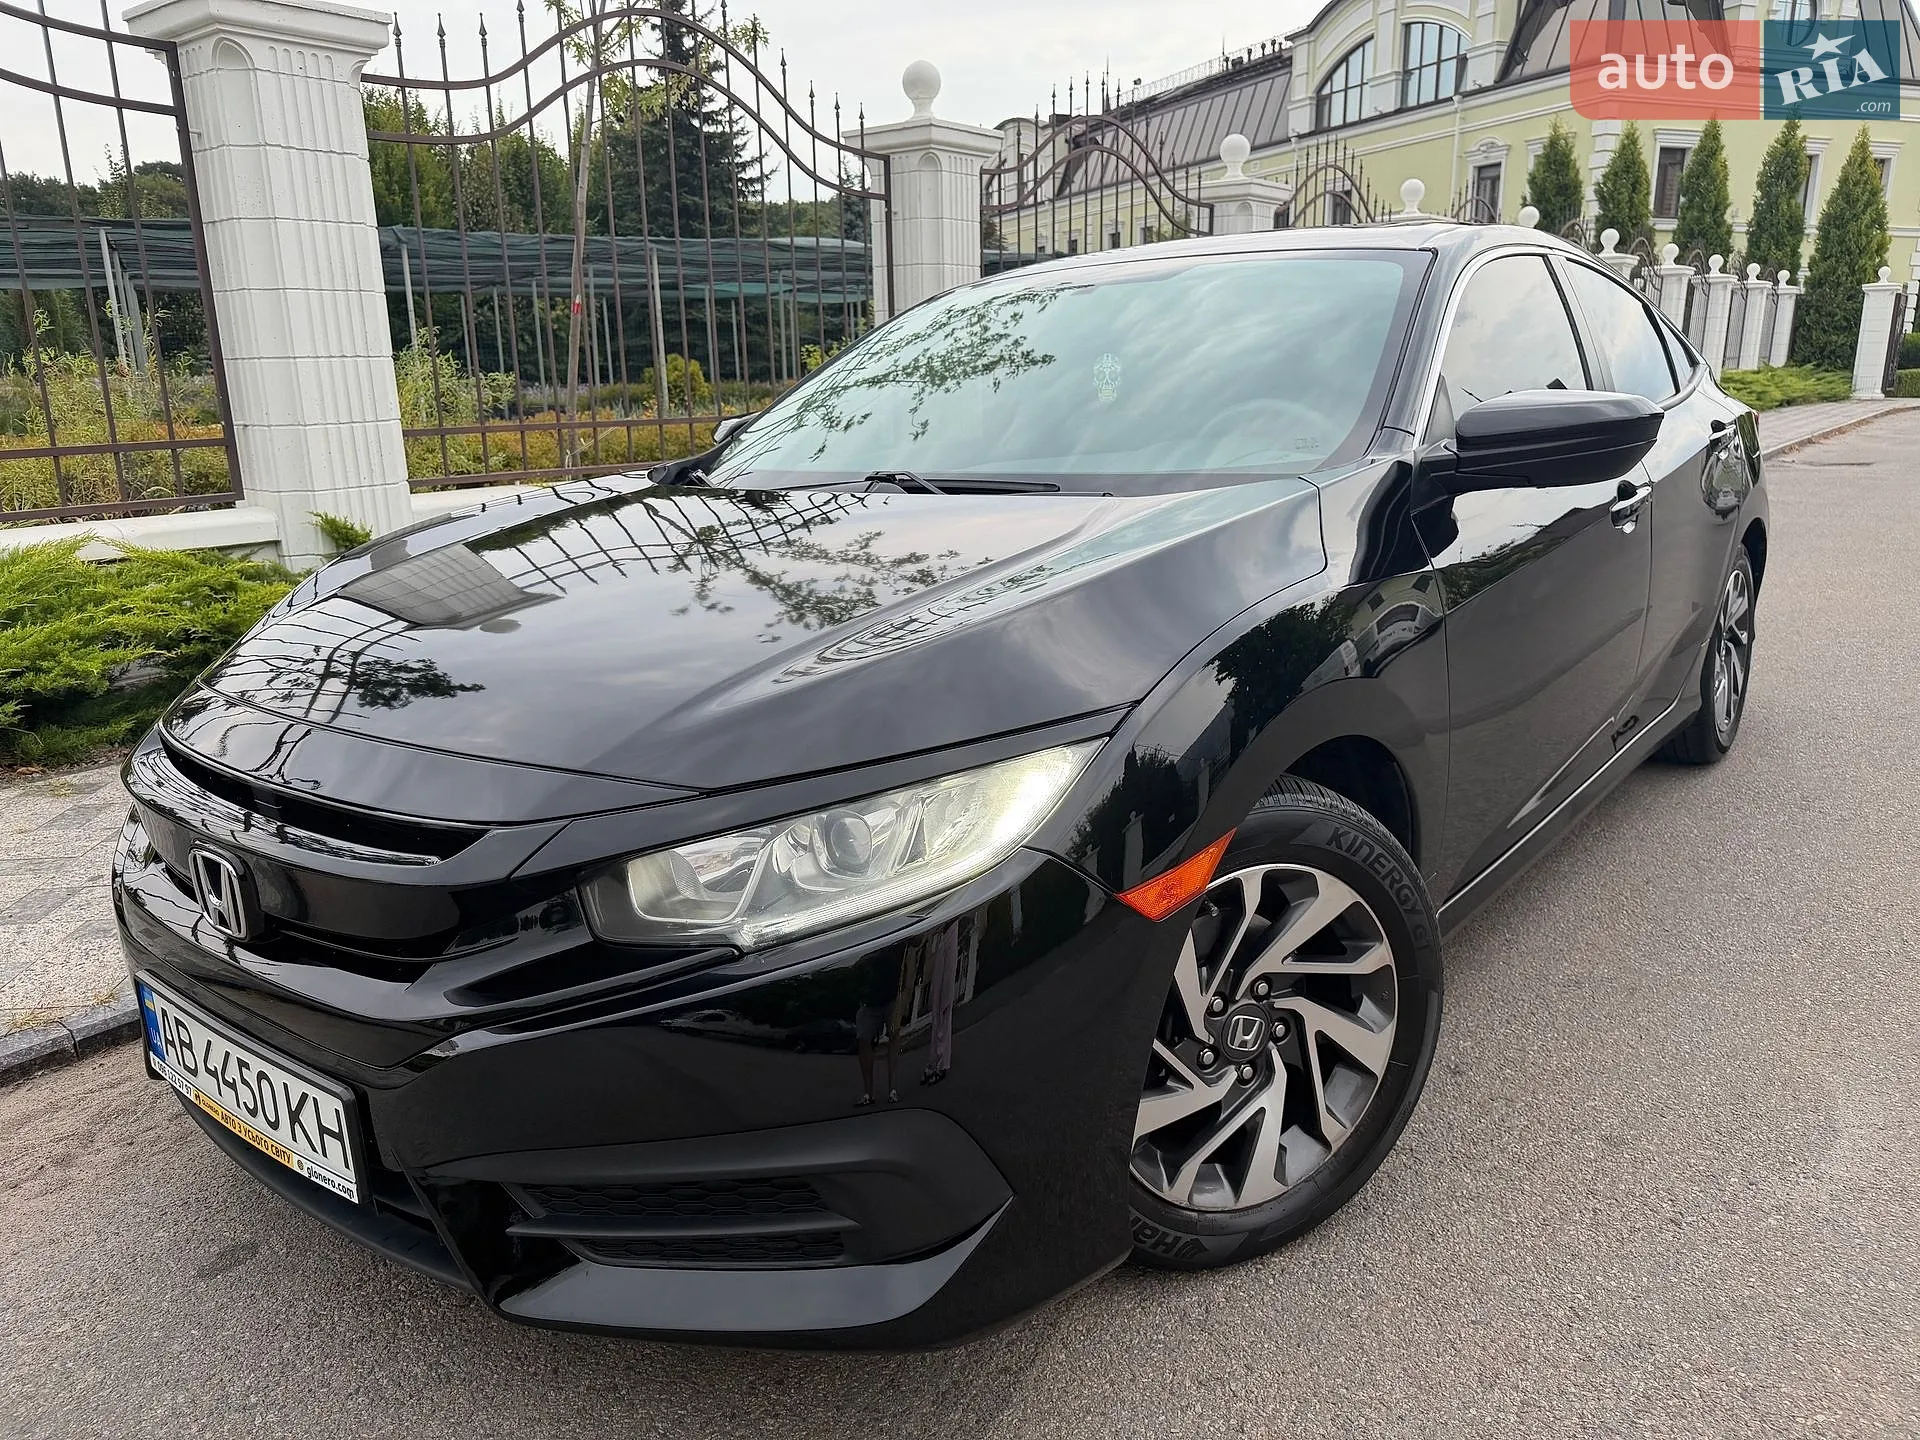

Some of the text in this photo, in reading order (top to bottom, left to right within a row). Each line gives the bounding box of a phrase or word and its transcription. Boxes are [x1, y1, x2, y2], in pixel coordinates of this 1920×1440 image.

[1326, 826, 1423, 914] KINERGY
[160, 1006, 351, 1169] AB 4450 KH
[306, 1165, 355, 1200] glonero.com
